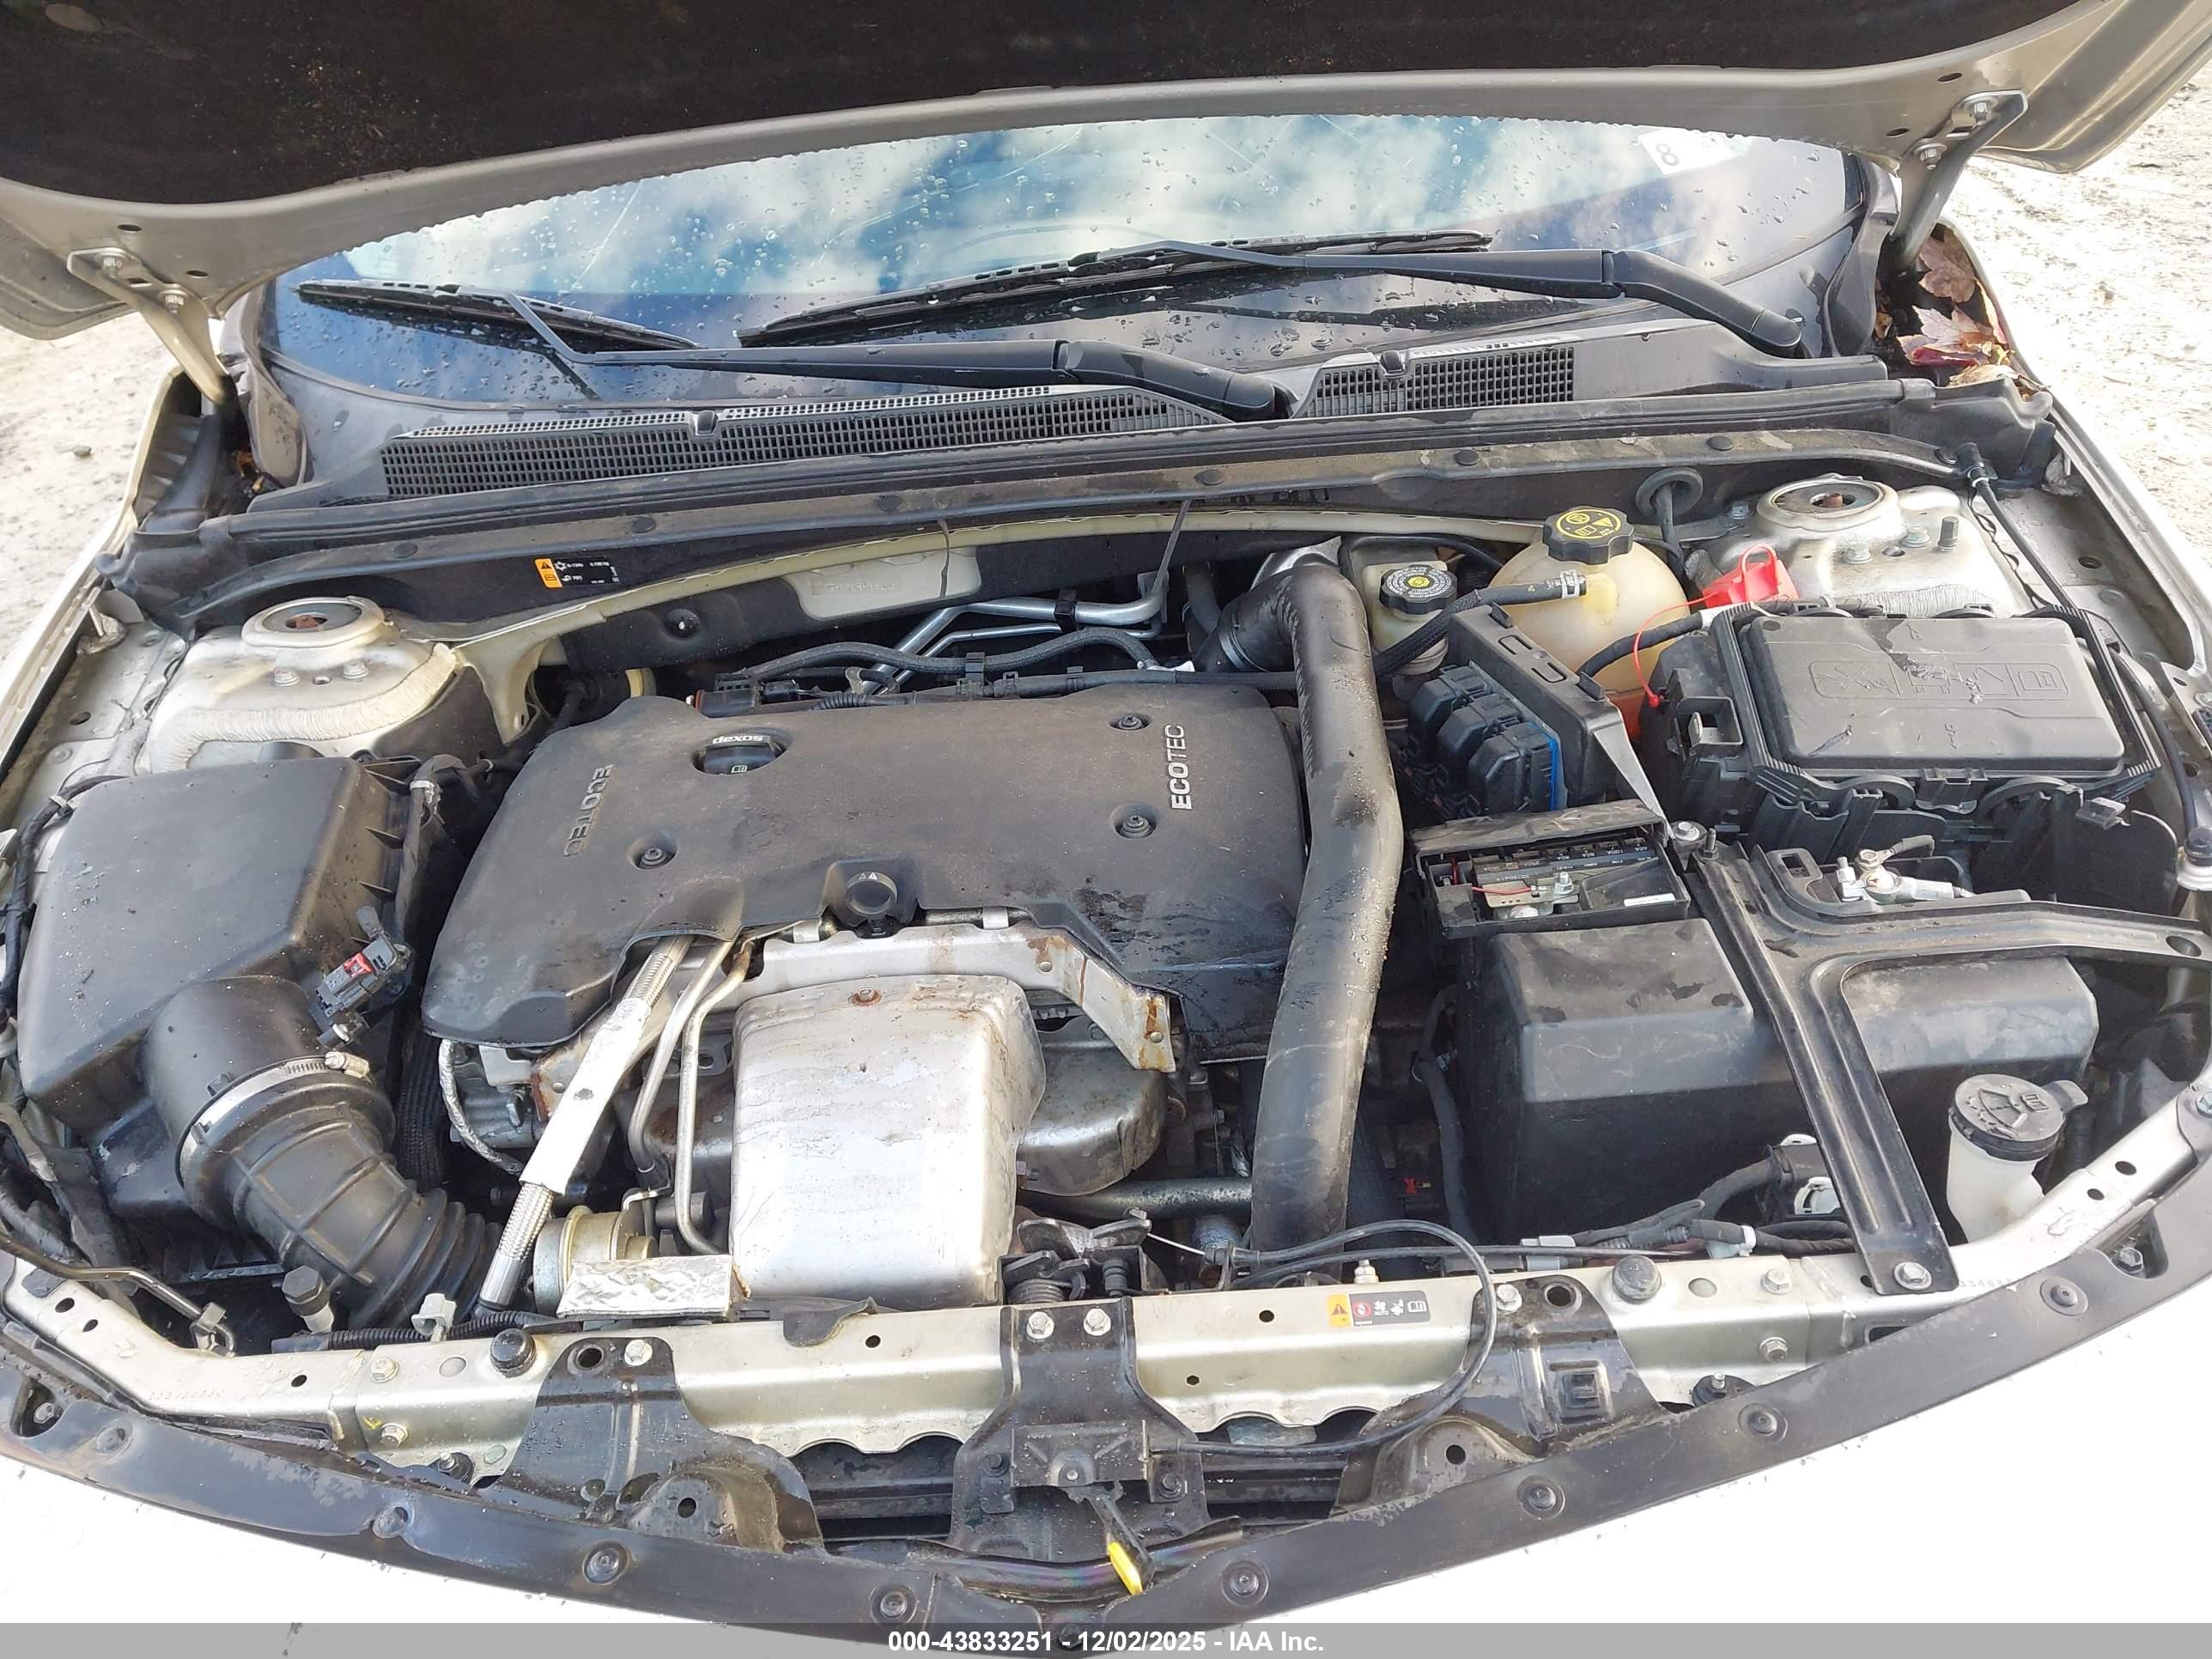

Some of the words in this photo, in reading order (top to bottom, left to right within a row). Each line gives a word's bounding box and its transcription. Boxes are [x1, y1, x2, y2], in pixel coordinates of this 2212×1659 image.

[1654, 143, 1680, 166] 8
[712, 735, 763, 744] dexos
[1164, 725, 1192, 810] ECOTEC
[563, 764, 612, 856] ECOTEC
